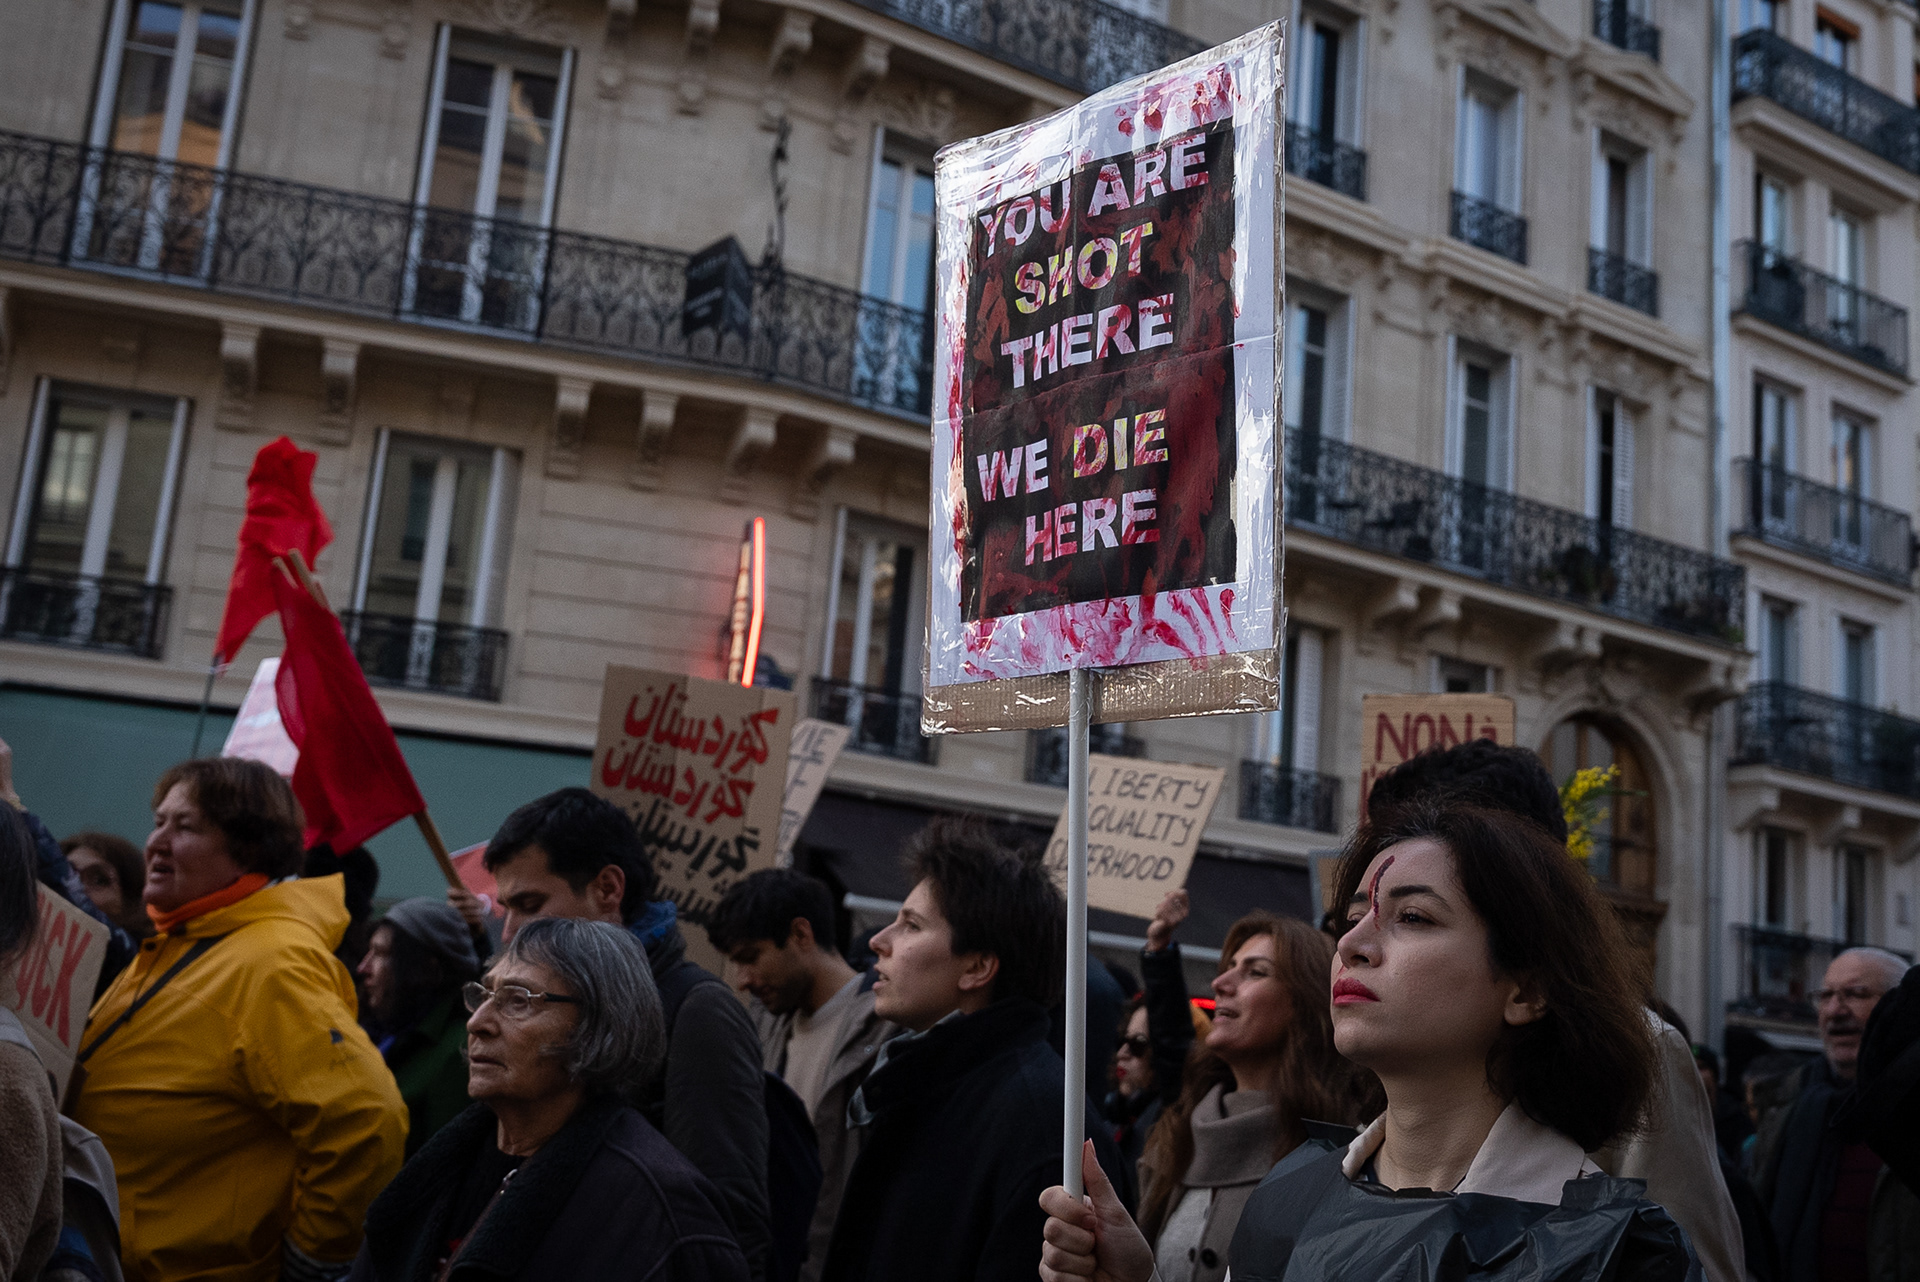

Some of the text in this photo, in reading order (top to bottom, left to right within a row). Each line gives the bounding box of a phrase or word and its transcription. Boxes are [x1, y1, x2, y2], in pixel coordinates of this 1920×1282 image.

[978, 132, 1209, 258] YOU ARE
[1014, 221, 1154, 315] SHOT
[1001, 293, 1174, 389] THERE
[976, 408, 1169, 502] WE DIE
[1025, 488, 1160, 566] HERE
[1087, 803, 1196, 847] QUALITY
[15, 890, 94, 1049] UCK
